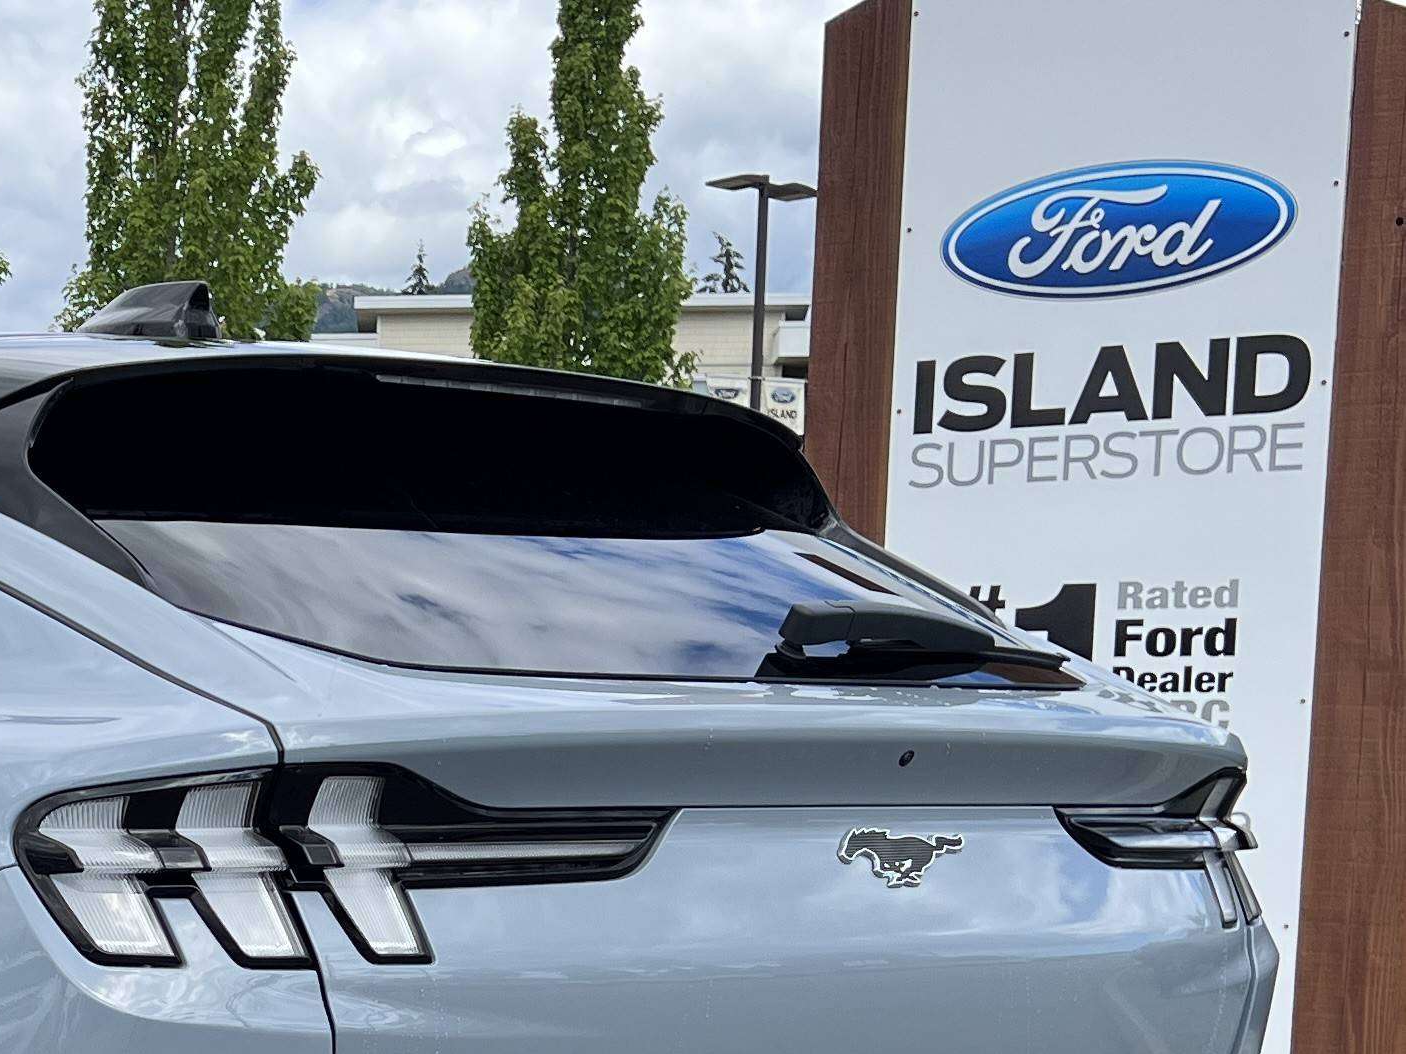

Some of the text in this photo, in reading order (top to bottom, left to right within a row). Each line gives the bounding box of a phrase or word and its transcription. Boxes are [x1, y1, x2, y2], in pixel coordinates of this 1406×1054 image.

[1008, 184, 1222, 278] Ford
[913, 335, 1311, 434] ISLAND
[909, 422, 1305, 488] SUPERSTORE
[1117, 579, 1239, 610] Rated
[1114, 618, 1237, 657] Ford
